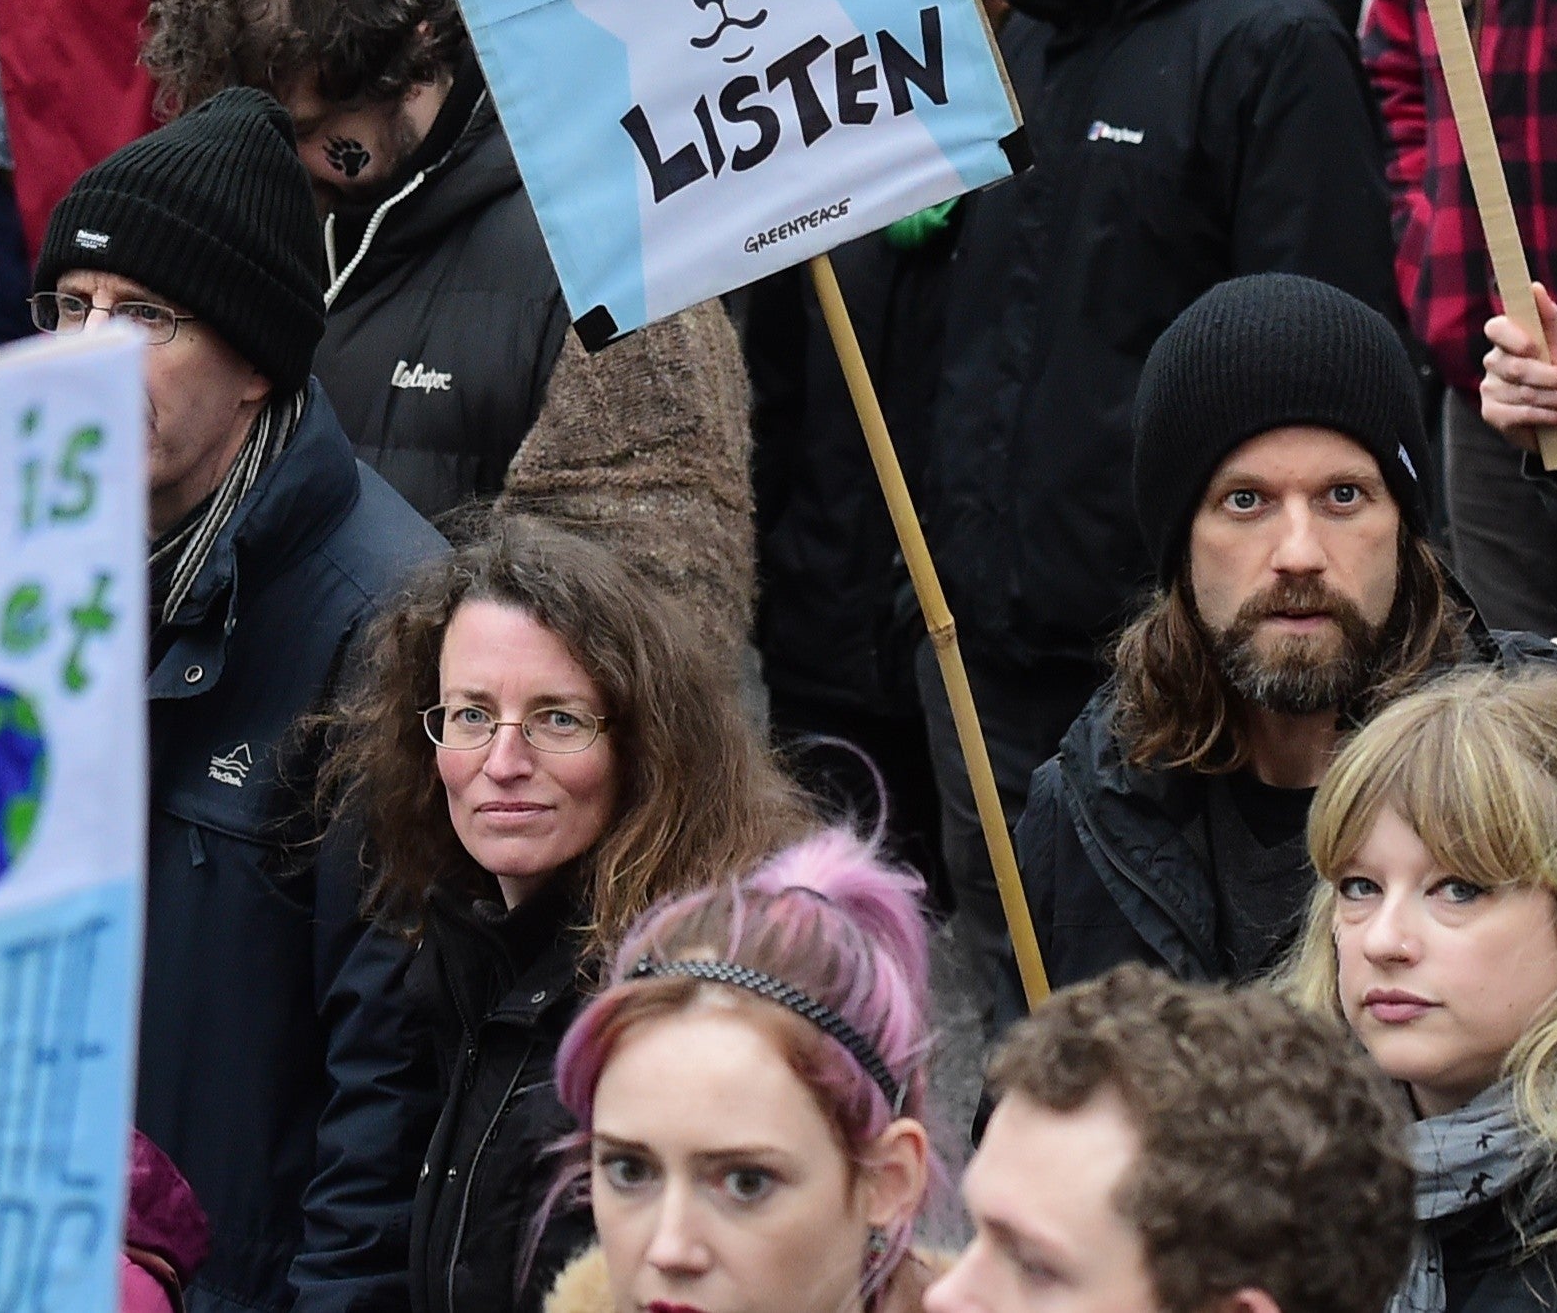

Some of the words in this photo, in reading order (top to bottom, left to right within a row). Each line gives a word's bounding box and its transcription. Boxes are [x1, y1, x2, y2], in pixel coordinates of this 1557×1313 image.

[619, 5, 949, 205] LISTEN
[743, 197, 852, 254] GREENPEACE
[17, 406, 106, 532] is
